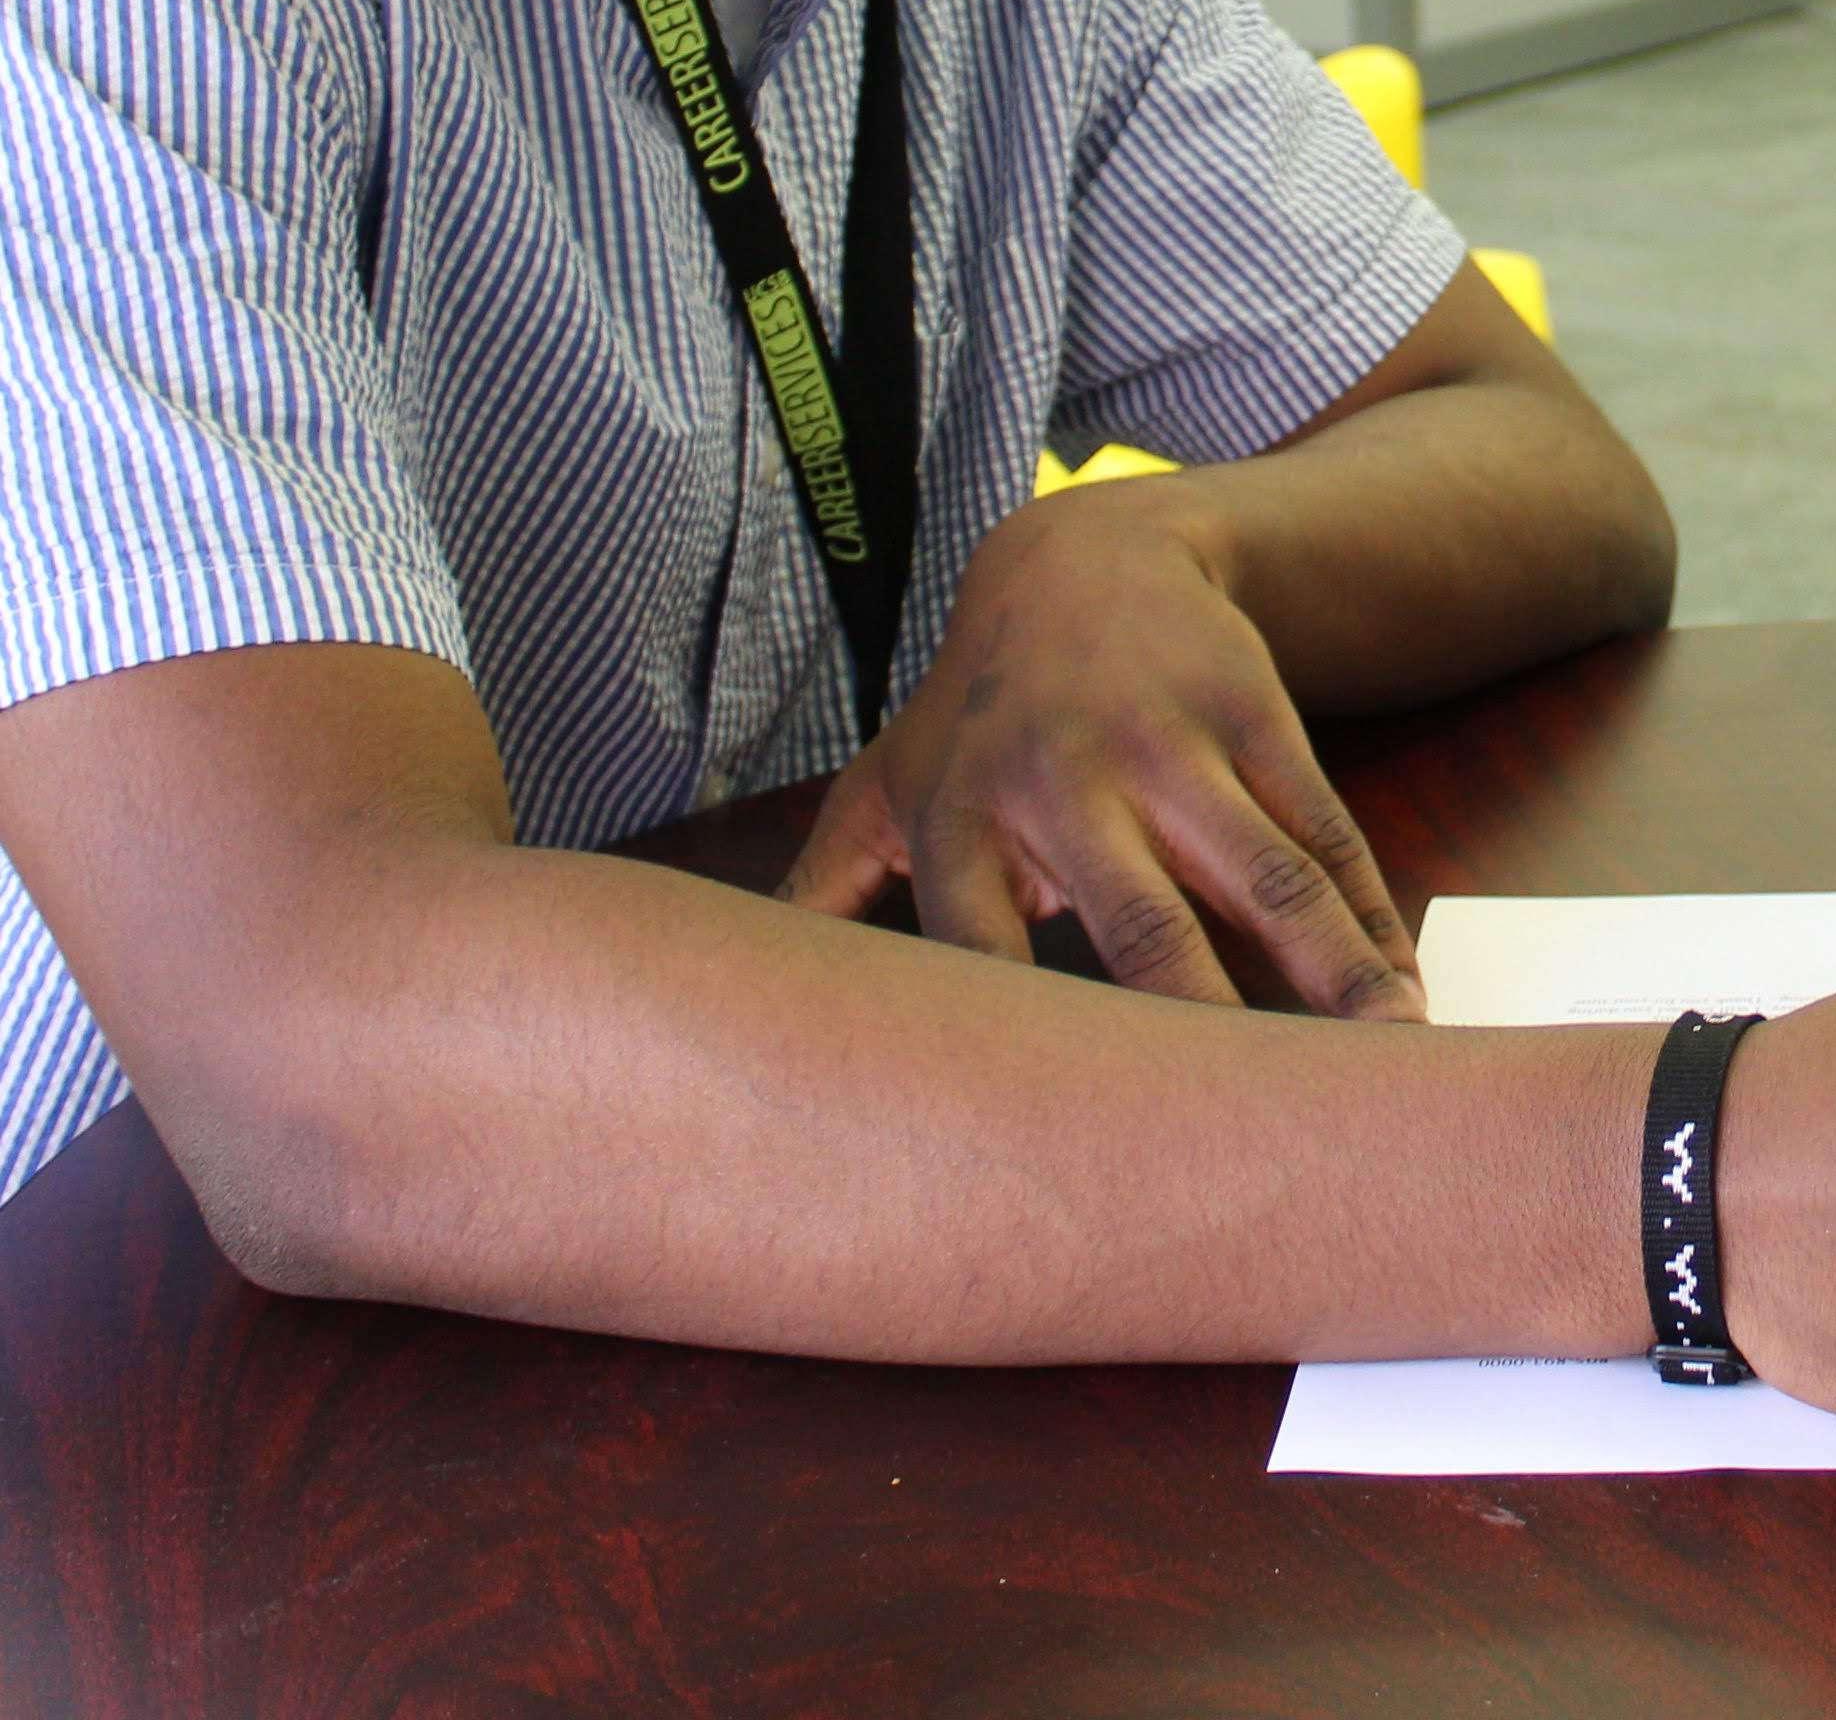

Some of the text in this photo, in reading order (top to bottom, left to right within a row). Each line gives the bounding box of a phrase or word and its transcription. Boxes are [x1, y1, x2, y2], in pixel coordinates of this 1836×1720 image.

[669, 49, 751, 194] CAREER
[753, 294, 868, 562] CAREER SERVICES
